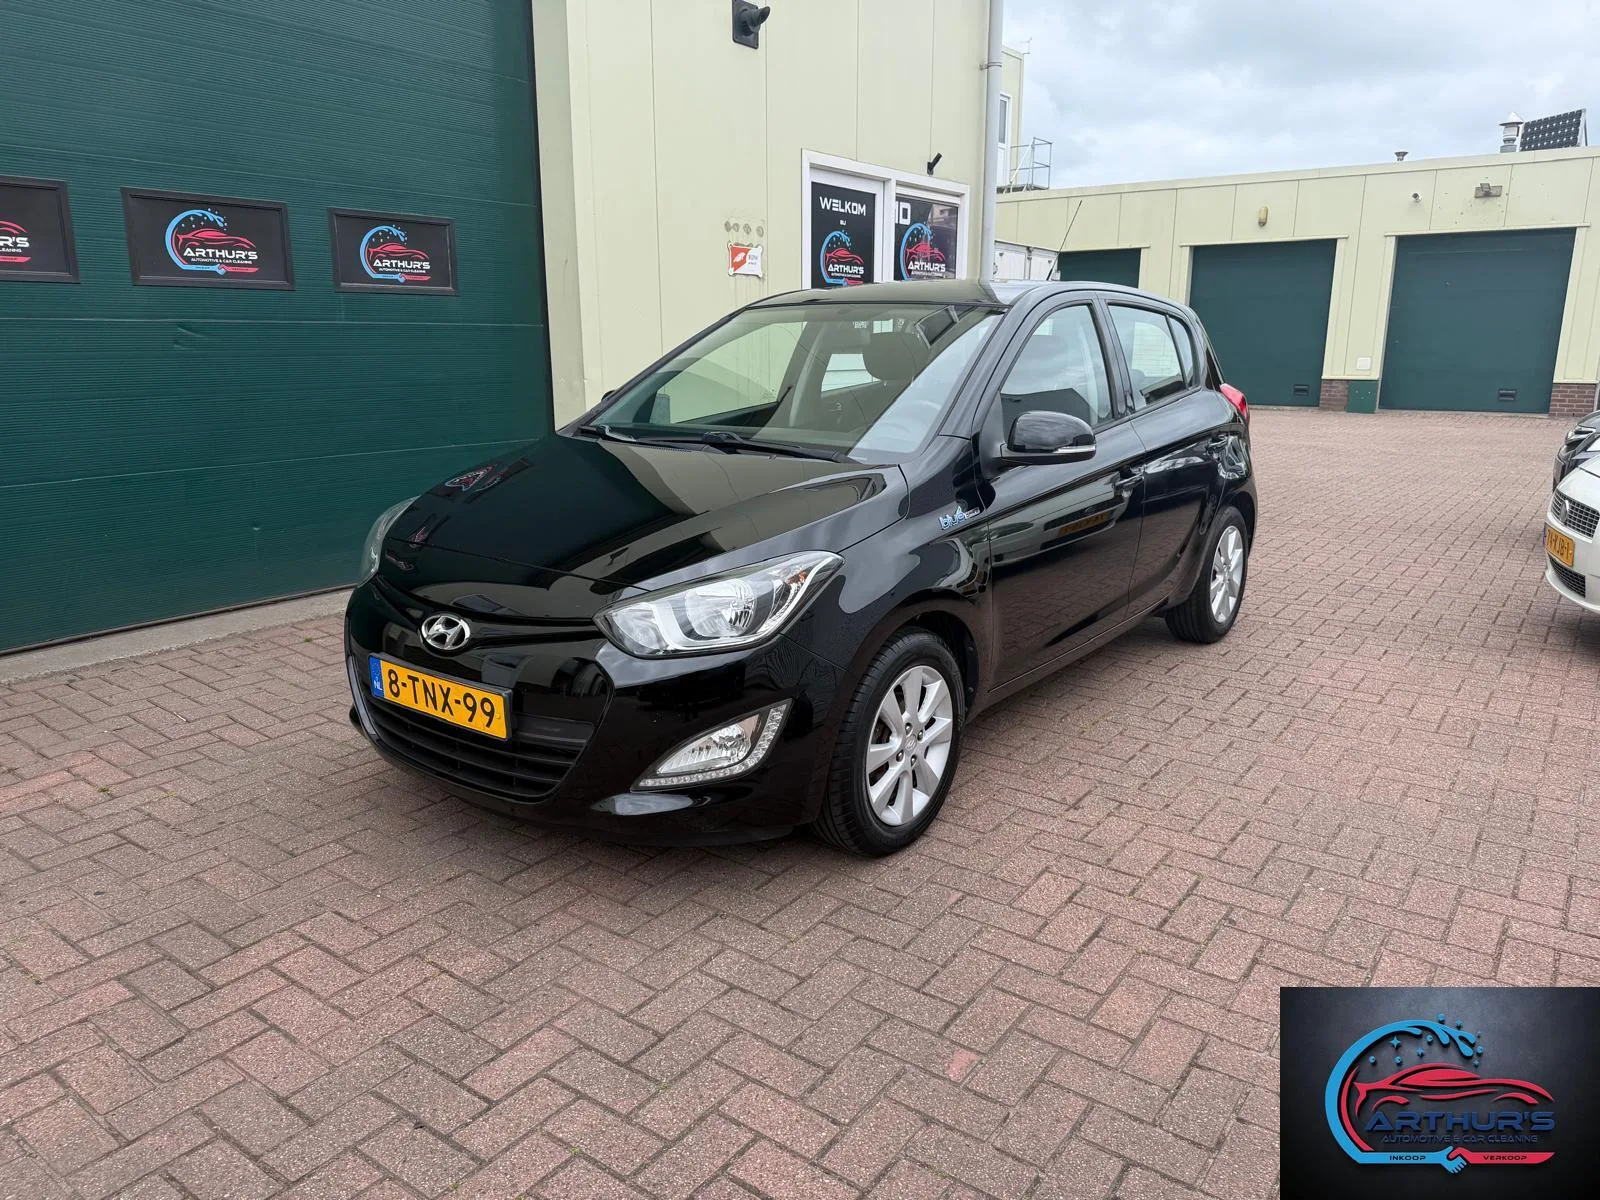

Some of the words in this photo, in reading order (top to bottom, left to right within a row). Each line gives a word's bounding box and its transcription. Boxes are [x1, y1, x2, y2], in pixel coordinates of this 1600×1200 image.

[819, 196, 866, 217] WELKOM
[183, 247, 259, 260] ARTHUR'S
[373, 259, 431, 270] ARTHUR'S
[827, 263, 865, 275] ARTHUR'S
[908, 261, 946, 273] ARTHUR'S
[373, 680, 383, 691] NL
[388, 668, 496, 729] 8-TNX-99
